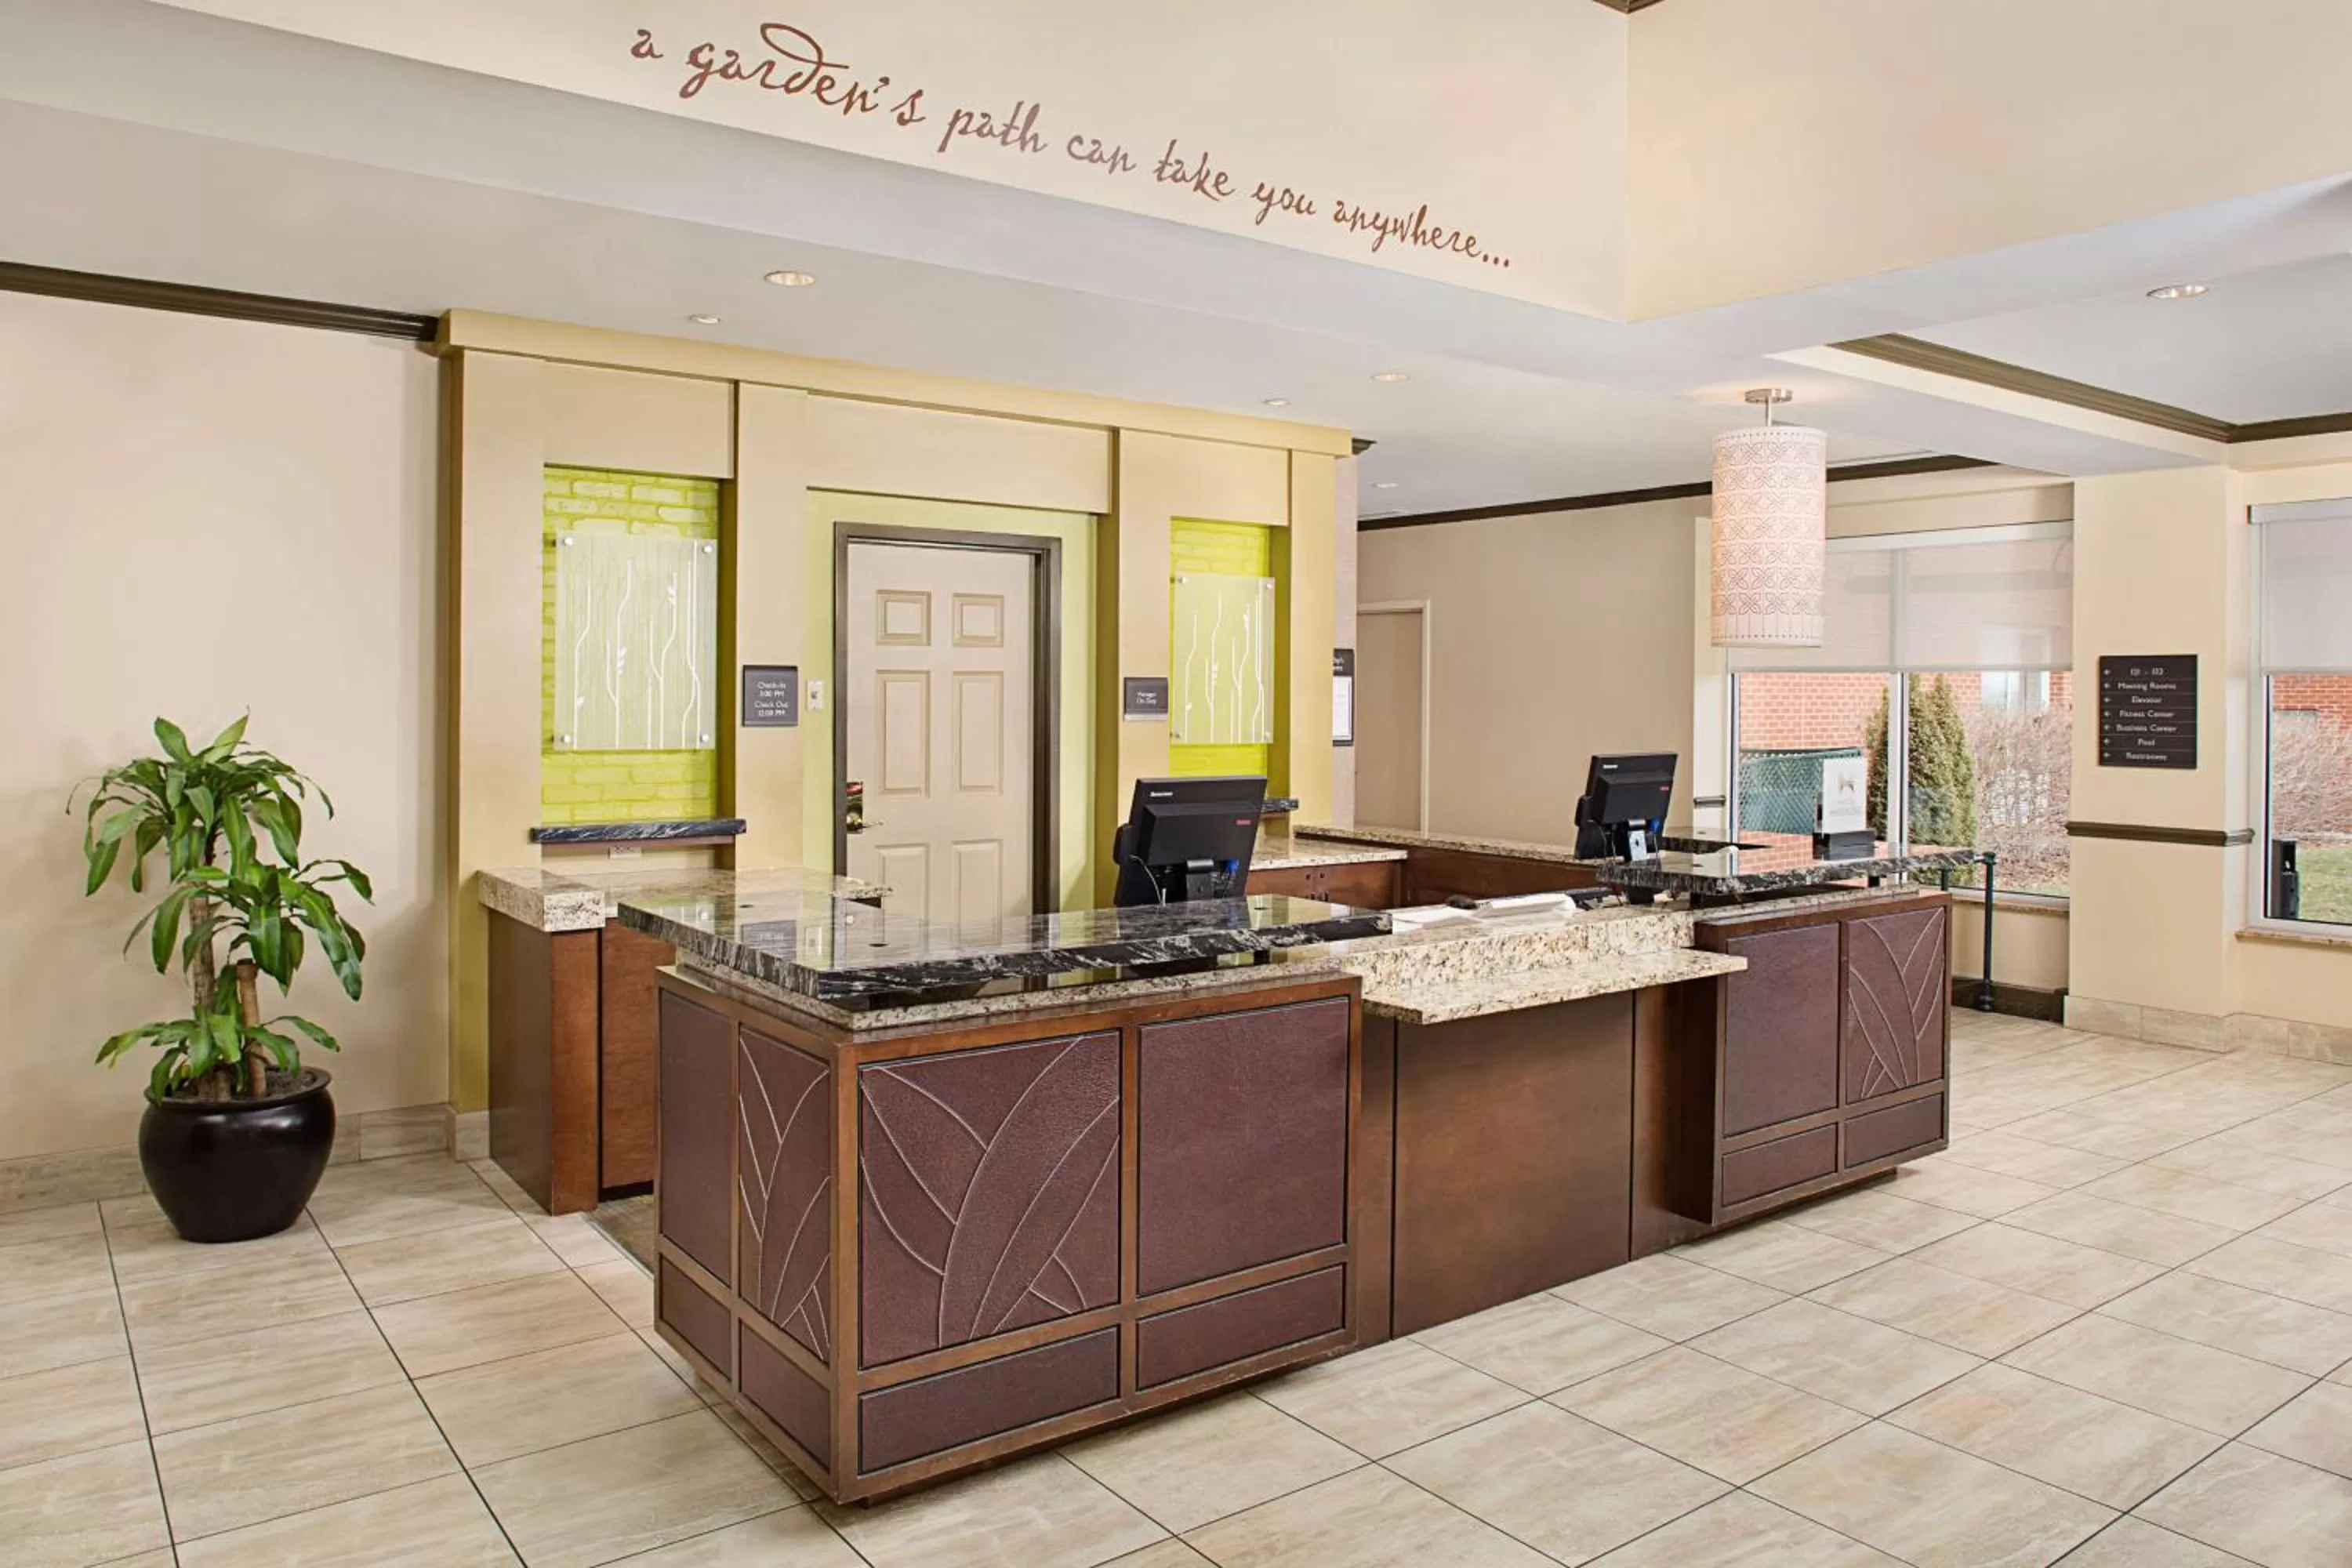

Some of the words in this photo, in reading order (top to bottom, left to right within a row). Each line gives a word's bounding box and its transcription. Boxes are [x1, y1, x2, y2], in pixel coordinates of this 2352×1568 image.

[630, 28, 664, 60] a
[678, 22, 927, 127] garden's
[936, 100, 1048, 154] path
[1066, 134, 1137, 174] can
[1153, 138, 1236, 201] take
[1250, 181, 1316, 226] you
[2149, 681, 2177, 690] Rooms
[2119, 709, 2146, 717] Fitness
[2147, 709, 2175, 717] Center
[2150, 724, 2177, 732] Center
